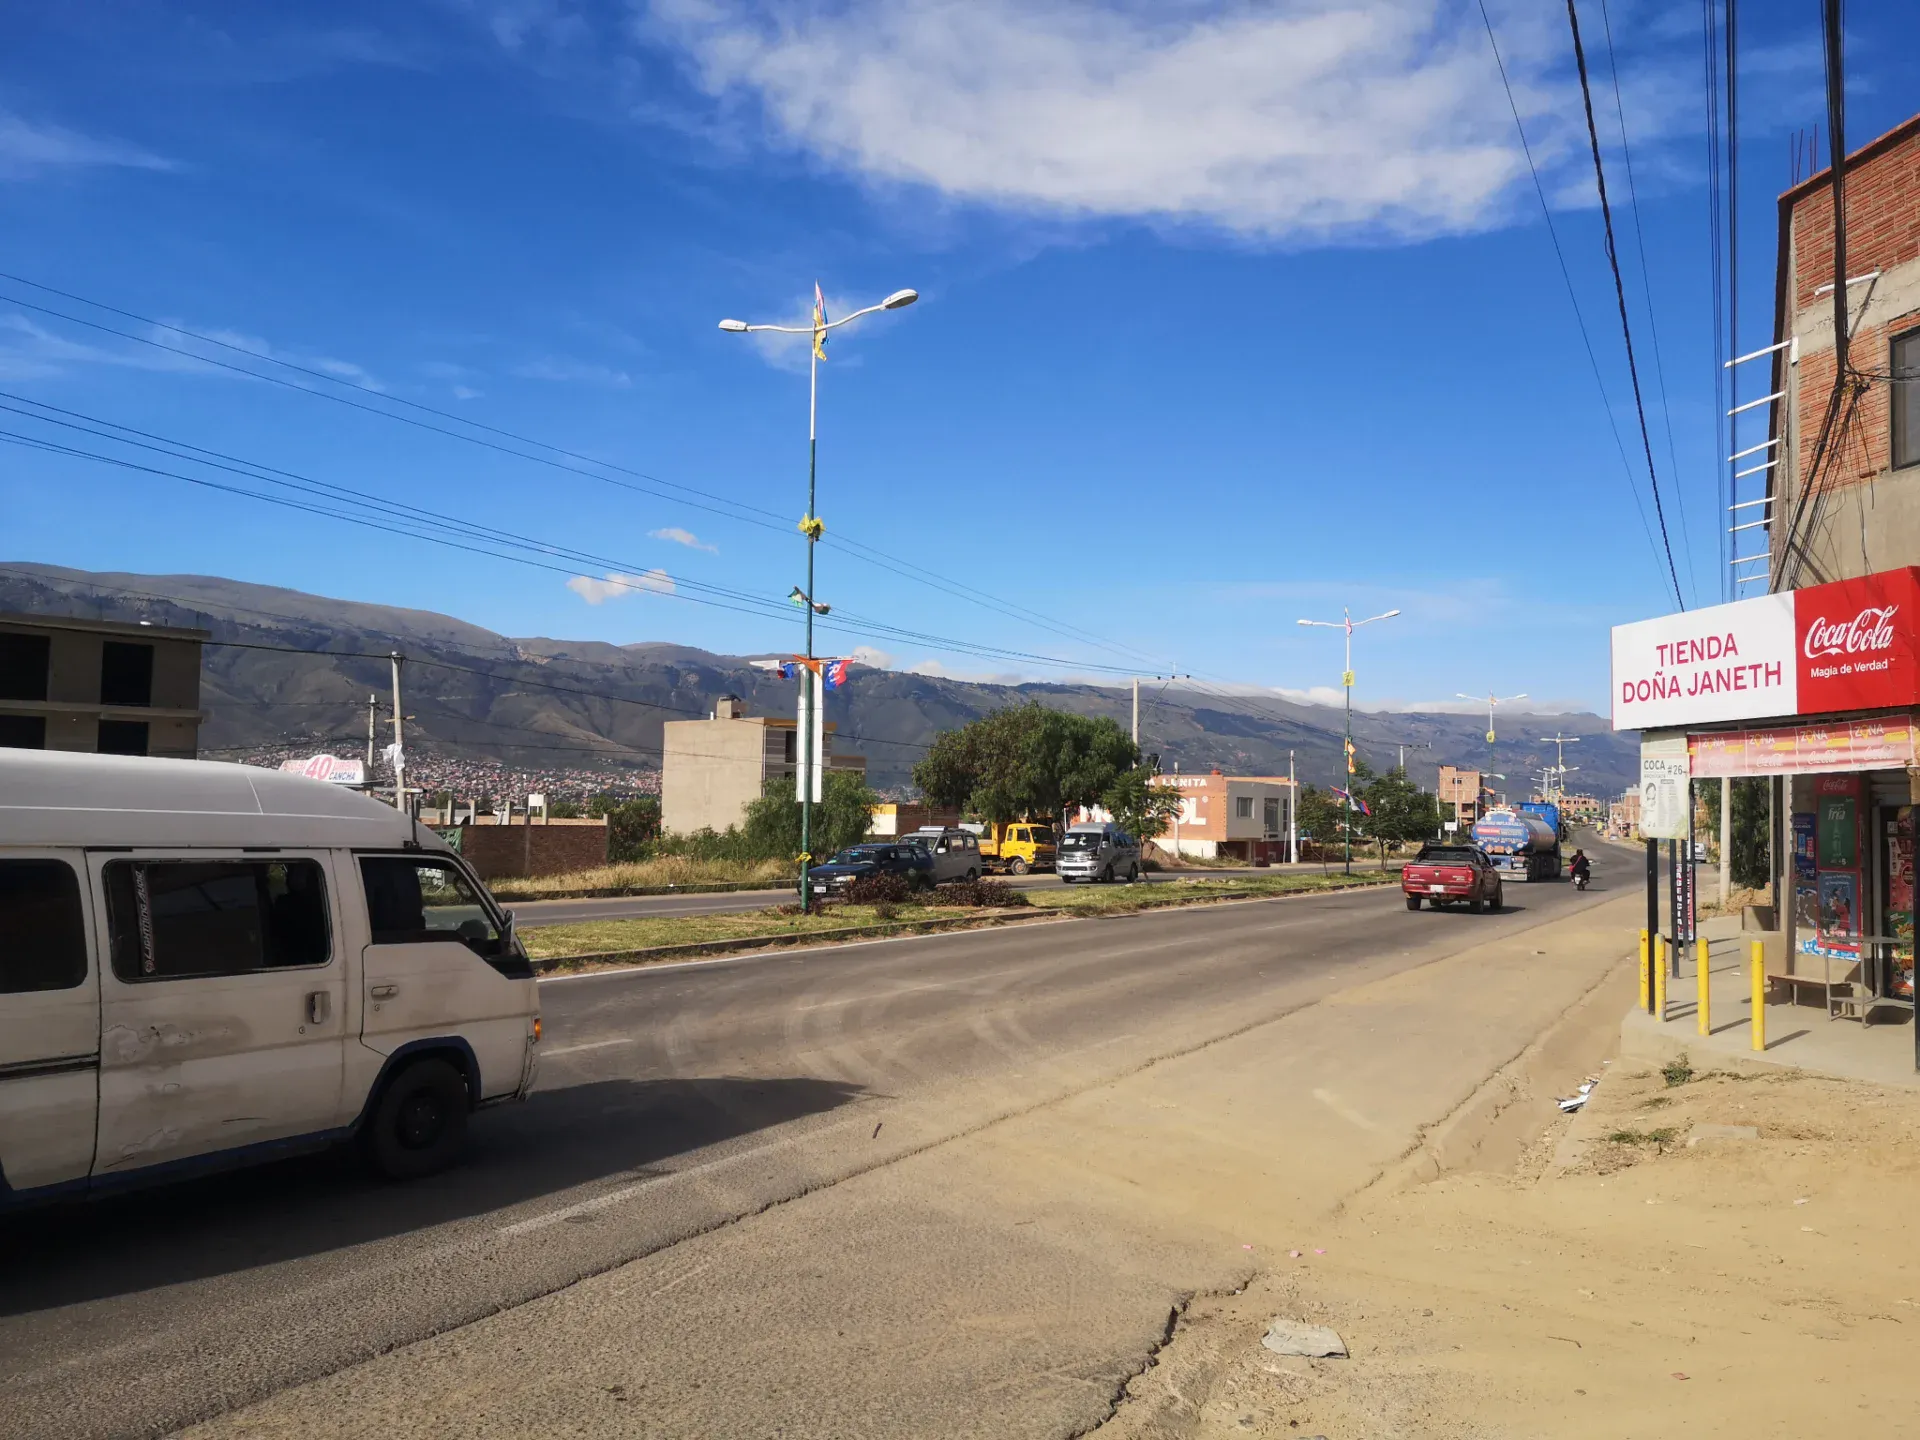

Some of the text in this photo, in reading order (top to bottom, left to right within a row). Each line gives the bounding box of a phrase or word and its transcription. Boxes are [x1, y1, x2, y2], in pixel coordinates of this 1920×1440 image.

[1804, 604, 1899, 659] Coca-Cola
[1656, 633, 1739, 667] TIENDA
[1622, 661, 1782, 704] DOÑA JANETH
[1811, 659, 1889, 679] Magia de Verdad
[304, 756, 333, 780] 40
[328, 772, 357, 781] CANCHA
[1643, 760, 1666, 771] COCA
[1162, 778, 1208, 788] LUNITA
[135, 870, 148, 904] AUDIO
[1675, 872, 1684, 926] AGENCIA
